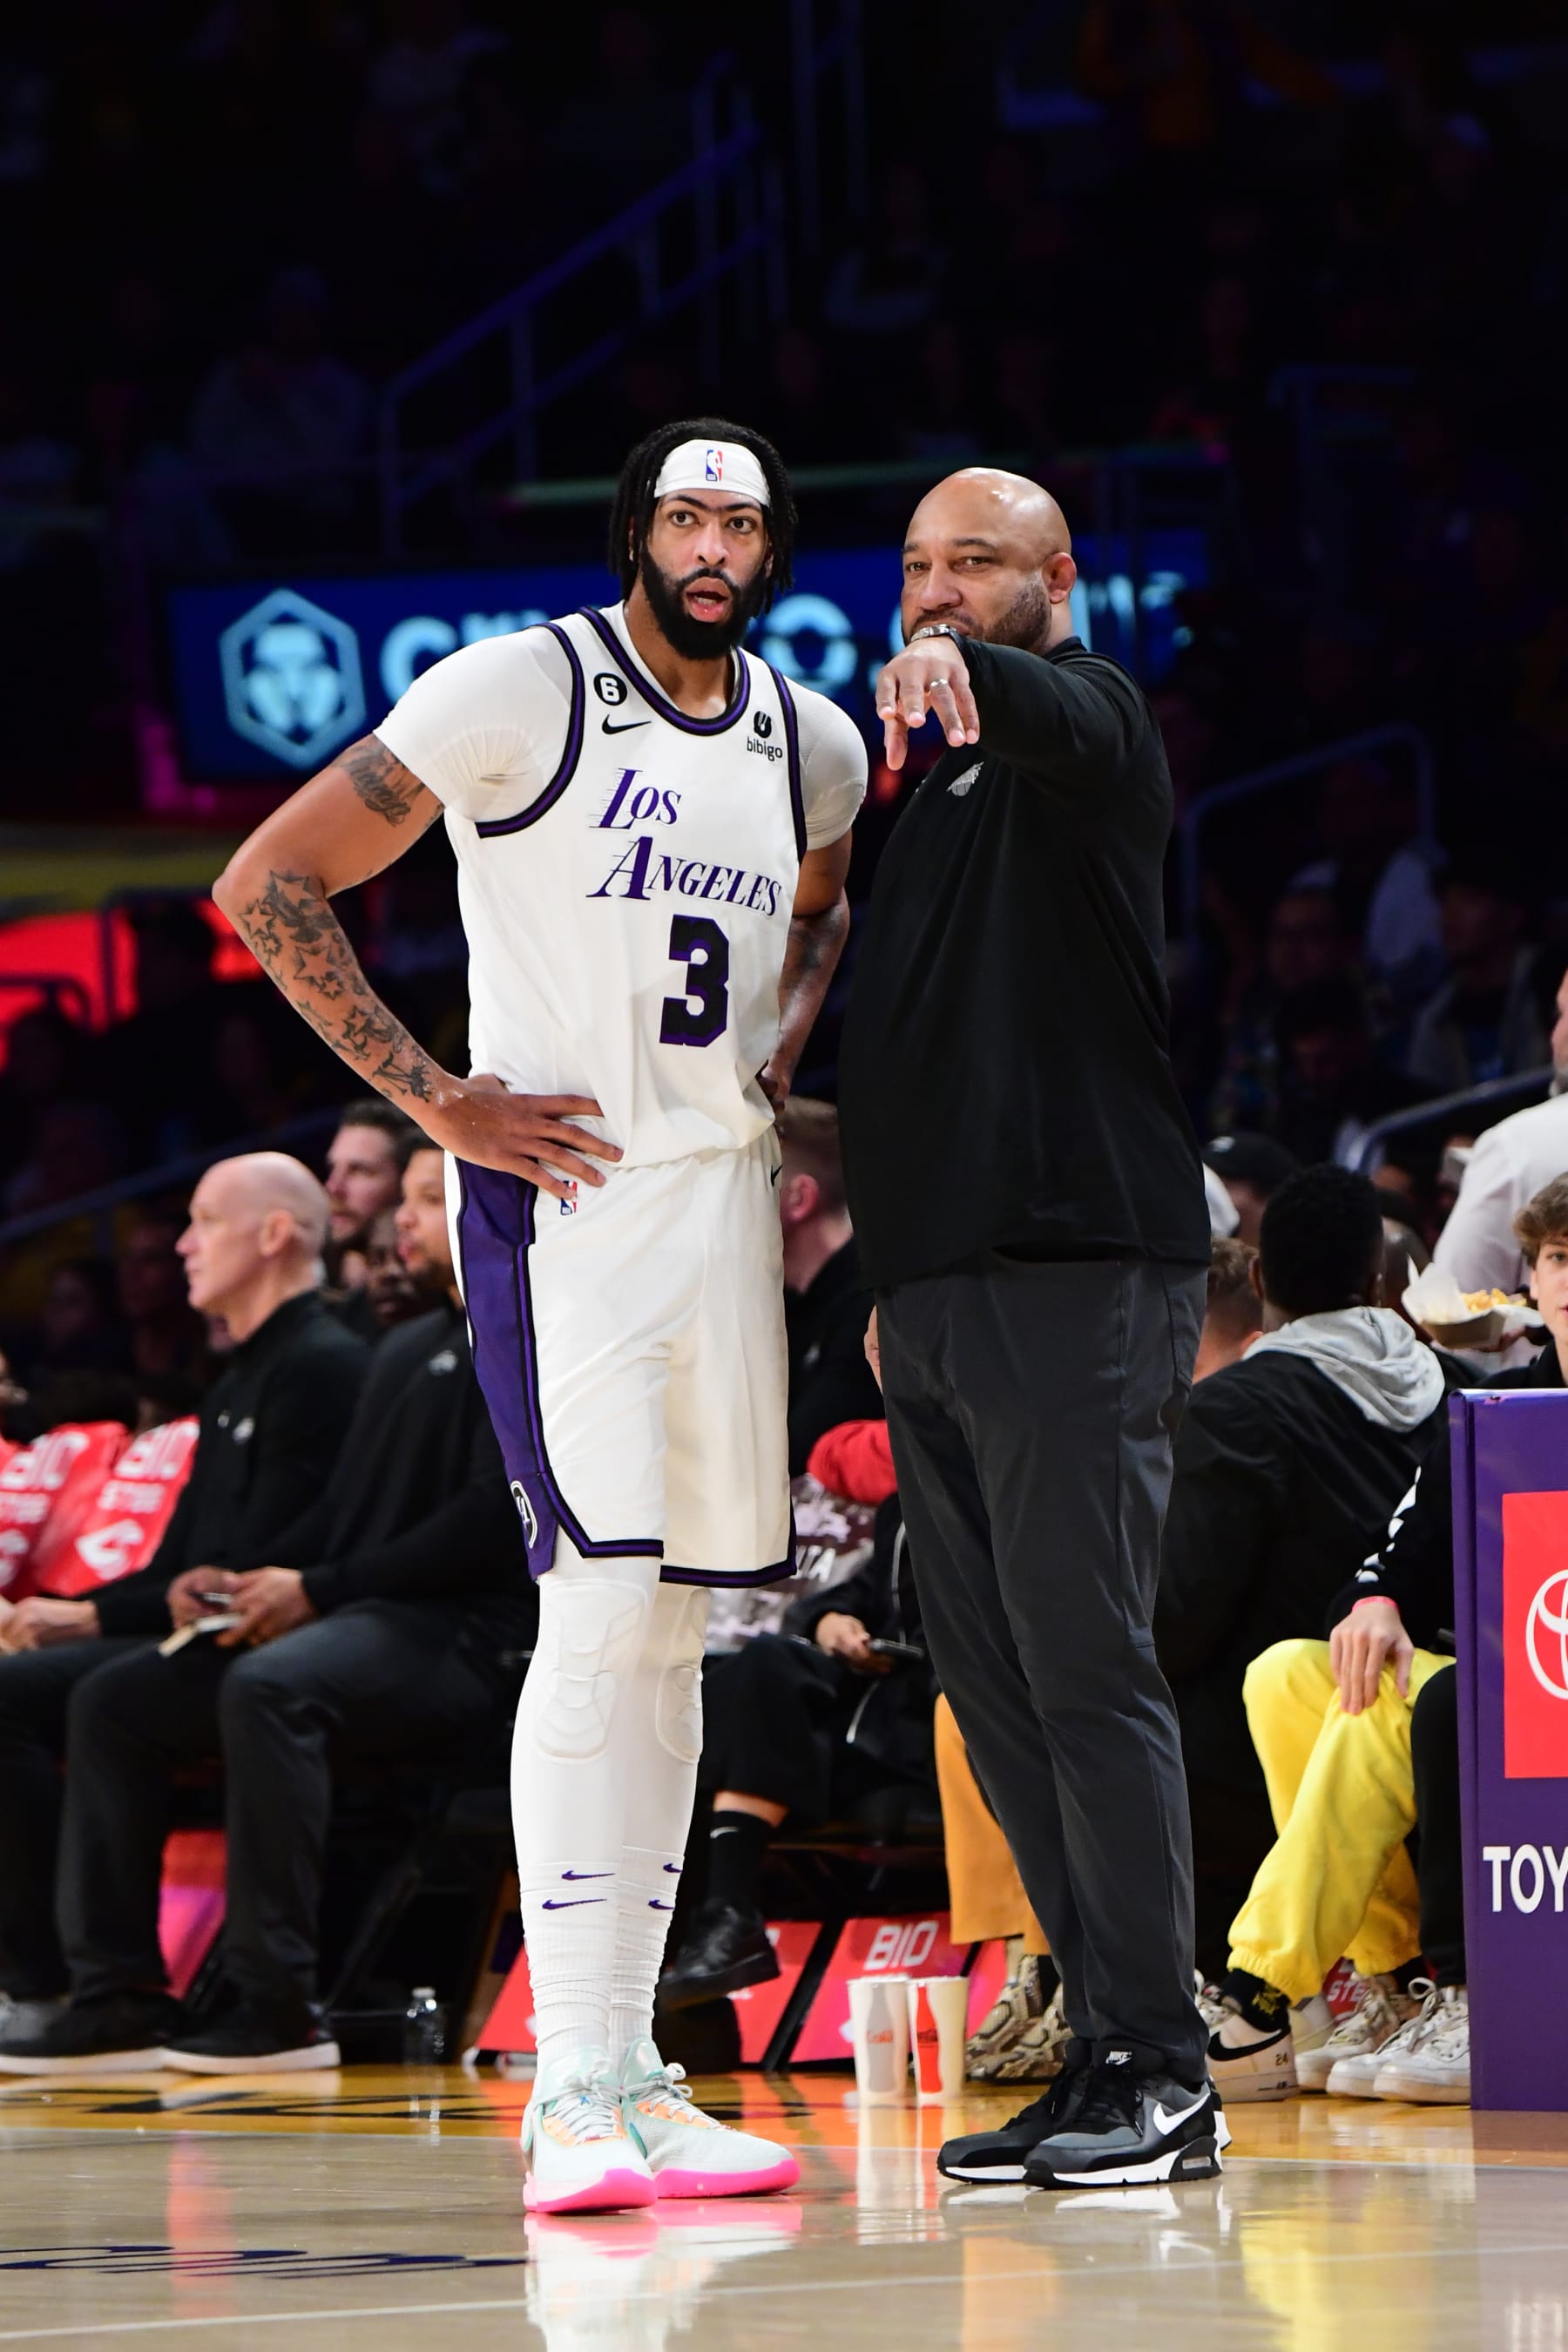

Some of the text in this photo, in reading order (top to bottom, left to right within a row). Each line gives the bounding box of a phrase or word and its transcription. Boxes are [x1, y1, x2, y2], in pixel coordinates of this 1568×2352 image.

[600, 676, 620, 703] 6
[747, 737, 783, 762] bibigo
[659, 914, 730, 1048] 3
[1483, 1843, 1568, 1914] TOY
[863, 1921, 939, 1970] BIO
[1107, 2051, 1131, 2063] NIKE
